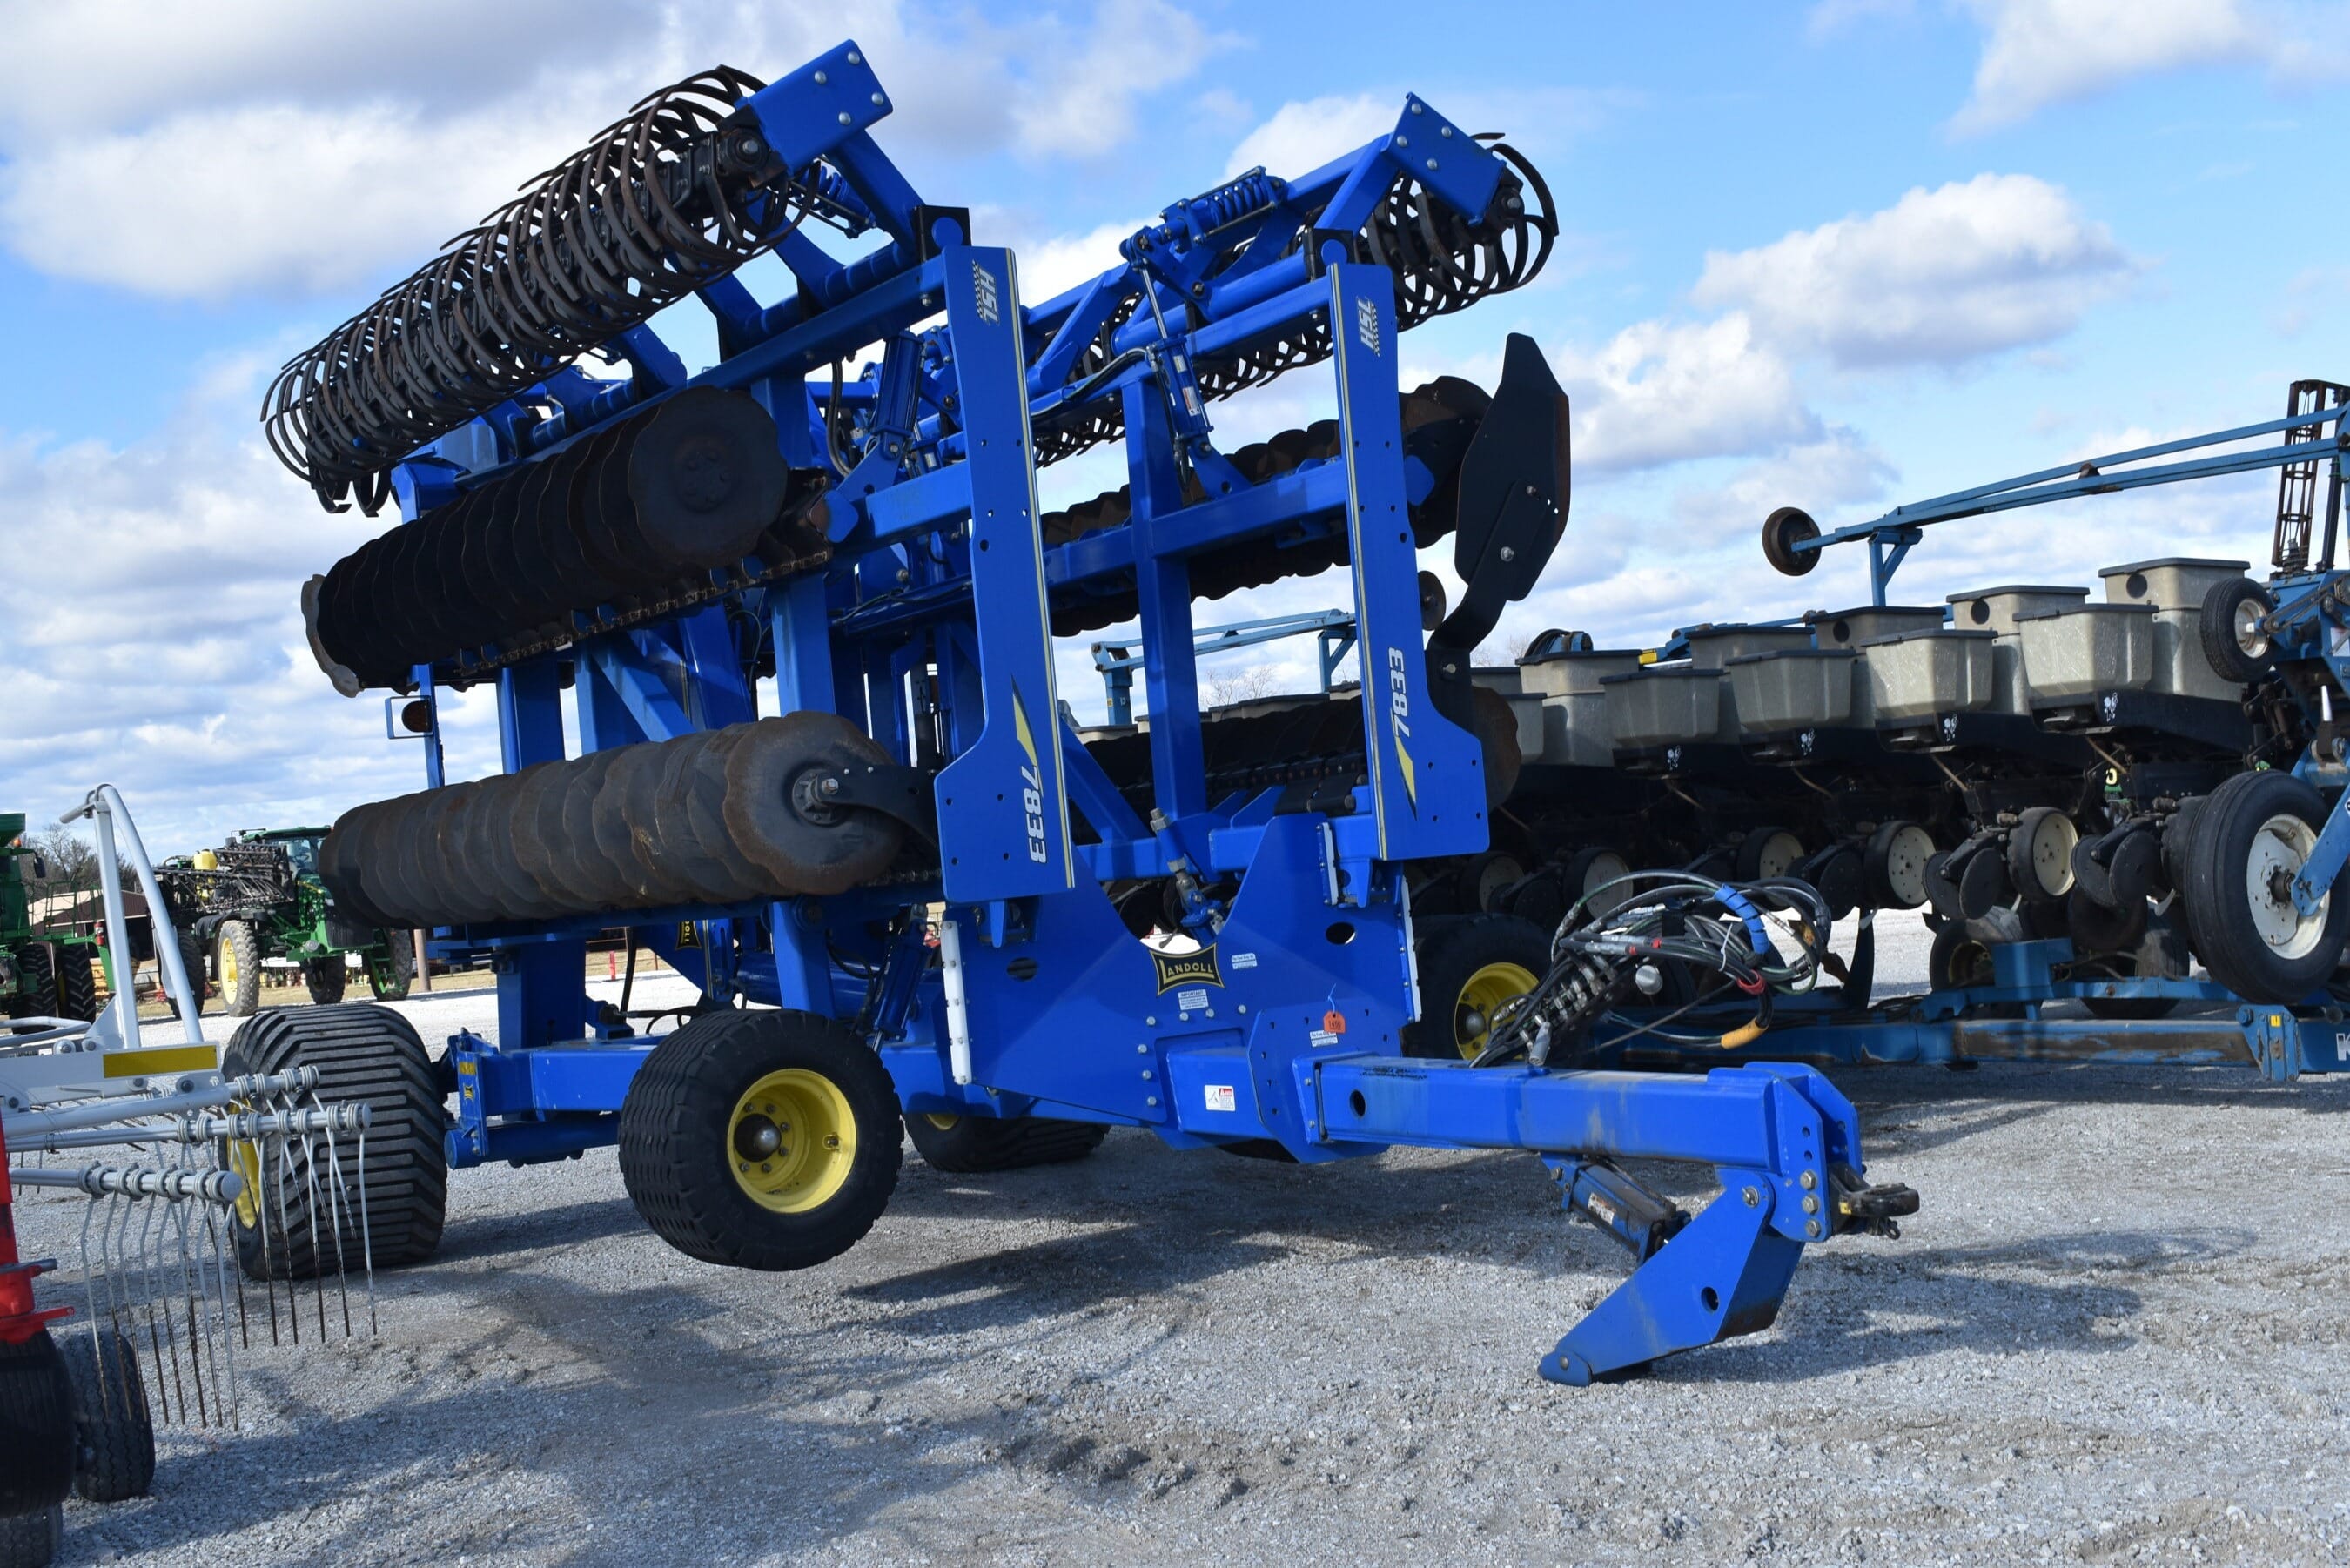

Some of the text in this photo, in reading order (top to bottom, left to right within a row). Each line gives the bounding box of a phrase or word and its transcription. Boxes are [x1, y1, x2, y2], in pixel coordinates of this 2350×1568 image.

[978, 266, 999, 324] HSL
[1357, 298, 1375, 351] HSL
[1388, 647, 1410, 738] 7833
[1021, 765, 1047, 863] 7833
[1159, 959, 1215, 985] LANDOLL
